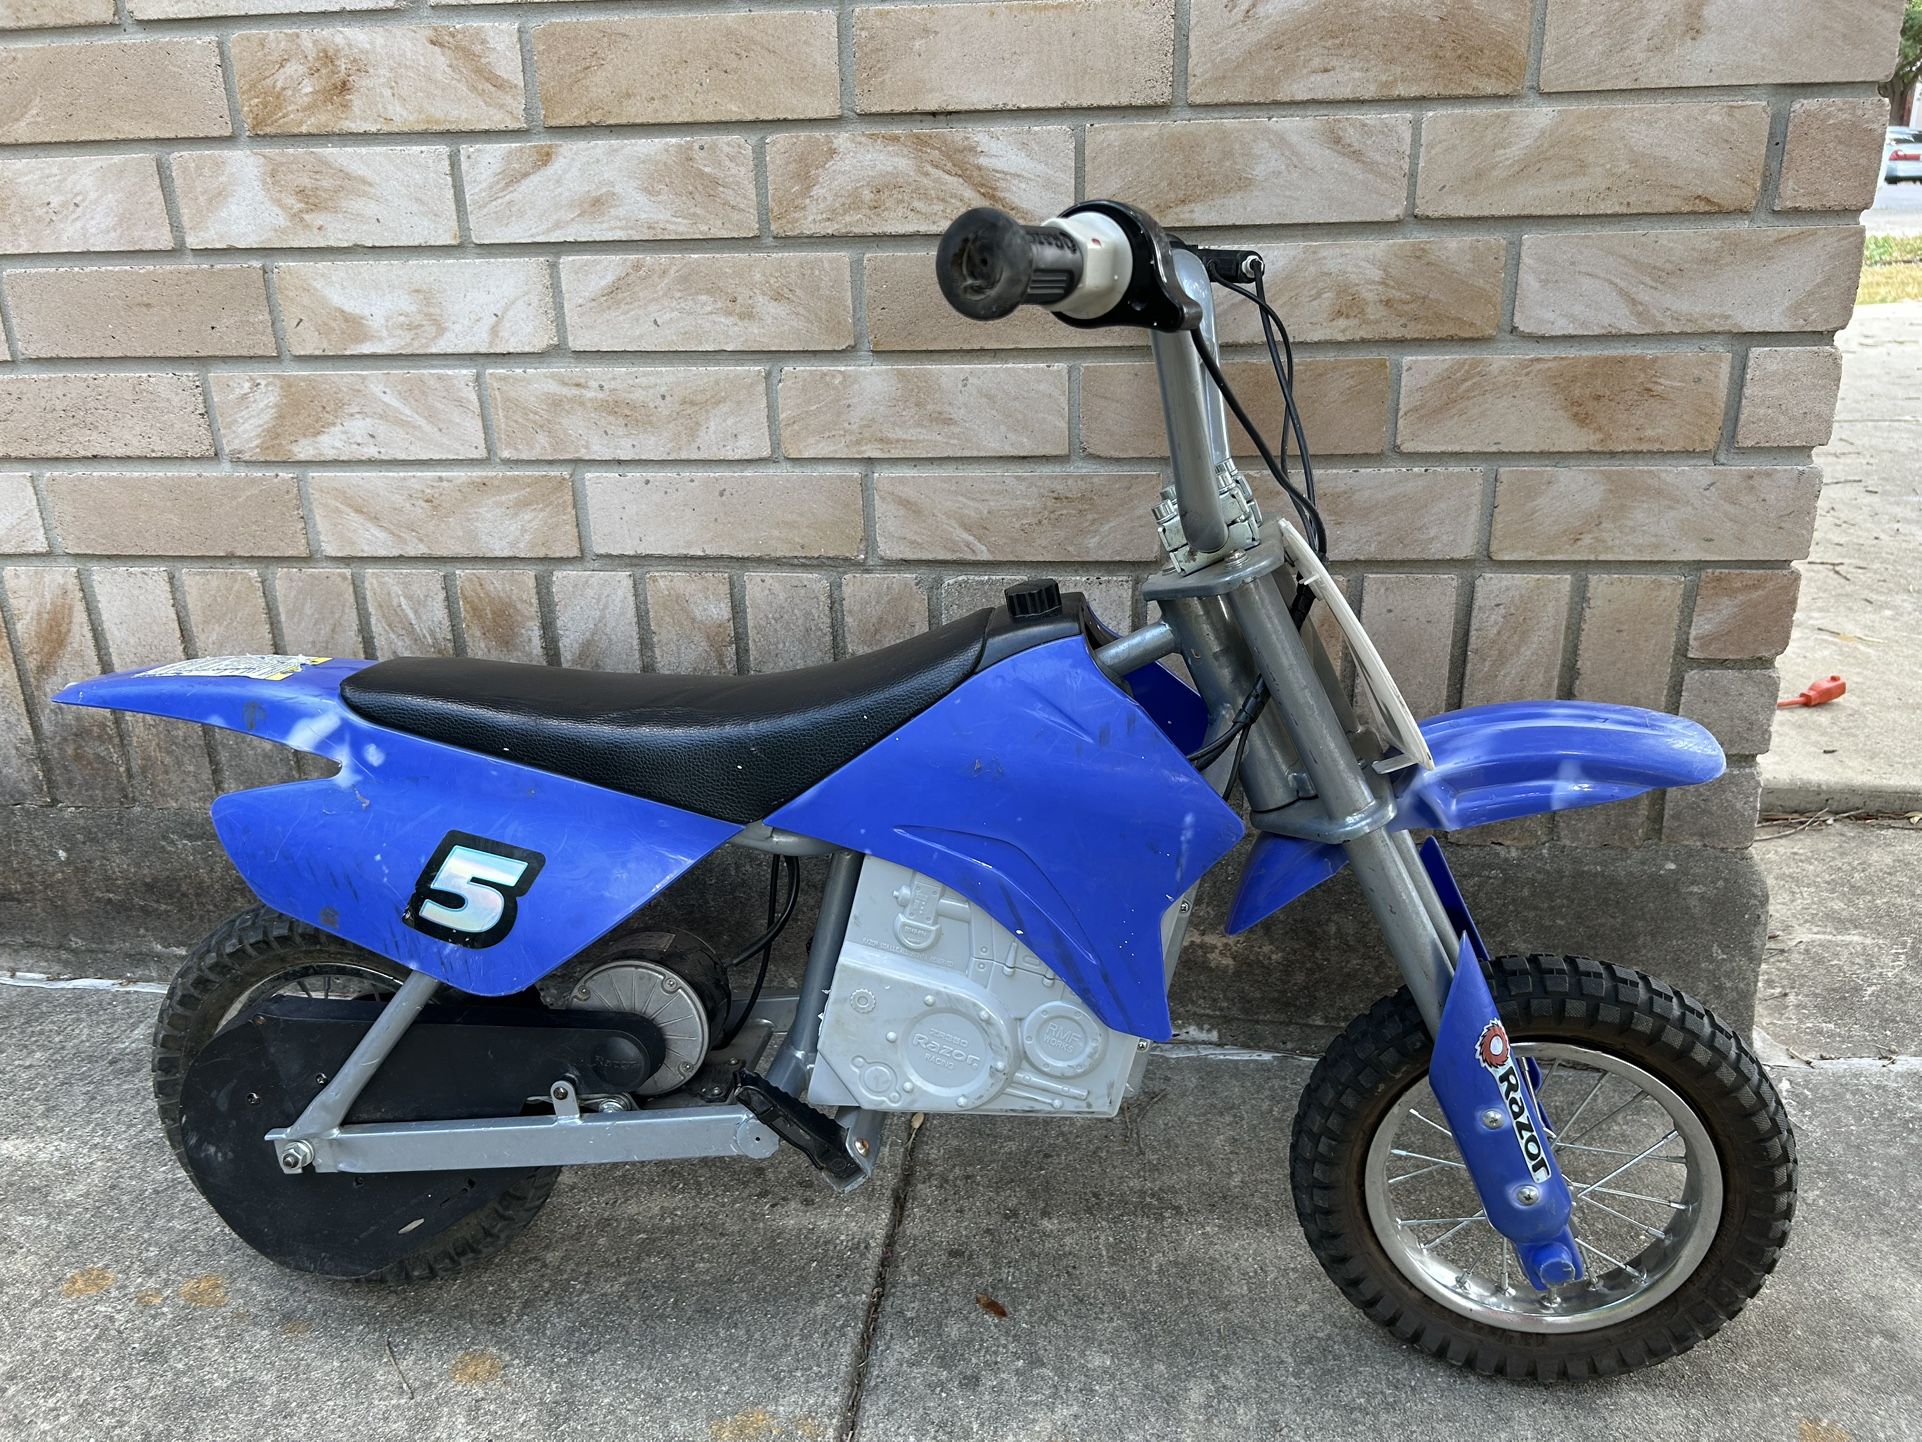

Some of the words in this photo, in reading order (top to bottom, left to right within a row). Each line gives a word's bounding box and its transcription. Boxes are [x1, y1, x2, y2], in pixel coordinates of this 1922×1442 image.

[411, 838, 537, 941] 5
[912, 1033, 981, 1066] Razor
[1042, 1034, 1074, 1054] WORKS
[1046, 1022, 1082, 1044] RMF
[1498, 1066, 1550, 1176] Razor
